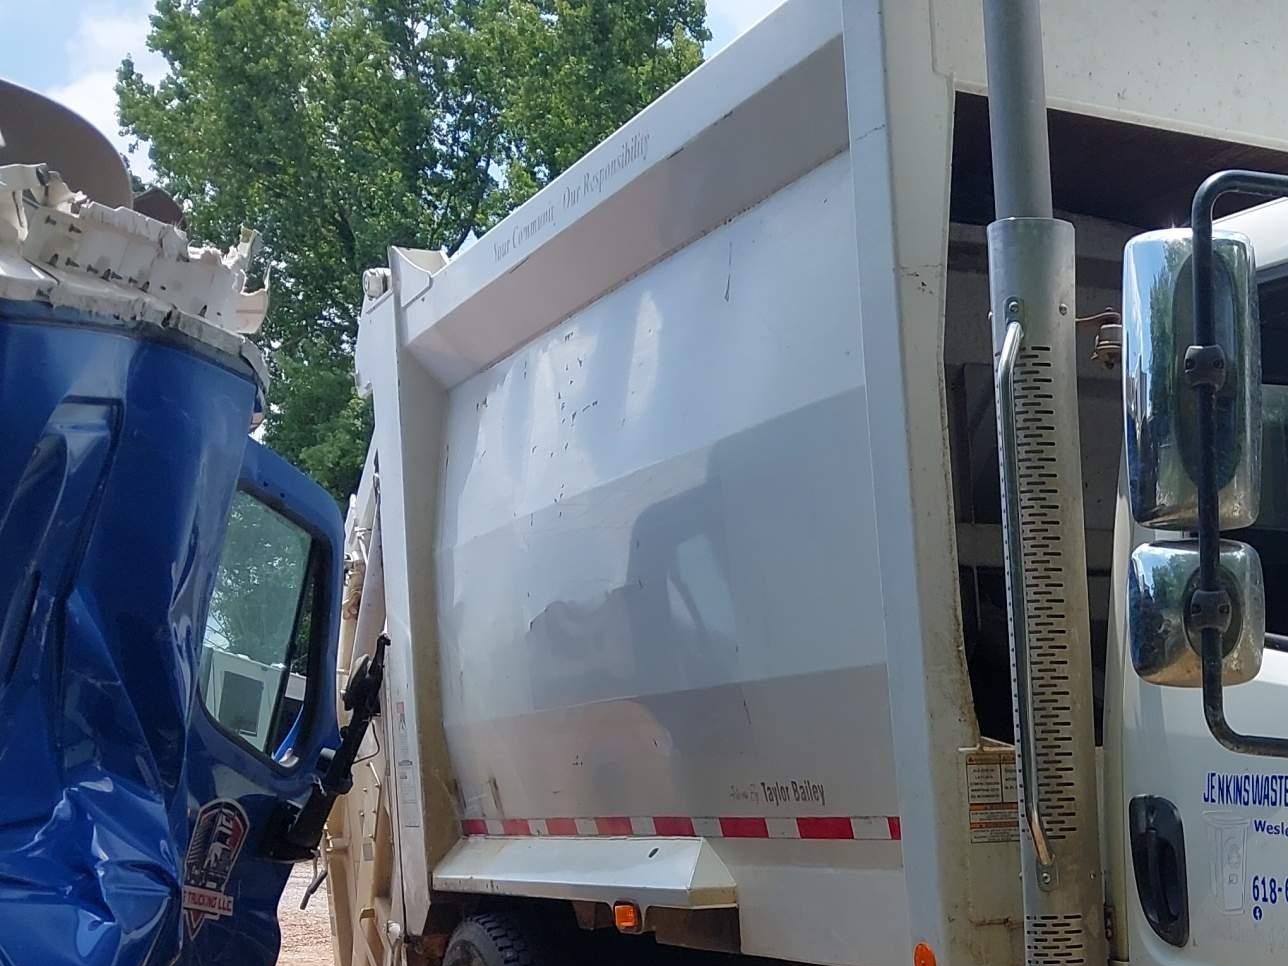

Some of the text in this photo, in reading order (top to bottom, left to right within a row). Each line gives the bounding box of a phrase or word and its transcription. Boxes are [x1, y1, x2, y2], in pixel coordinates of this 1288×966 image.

[562, 184, 581, 209] Our
[583, 130, 652, 197] Responsibility
[760, 781, 791, 806] Taylor
[791, 779, 825, 806] Bailey
[1203, 772, 1250, 806] JENKINS
[218, 898, 232, 912] LLC
